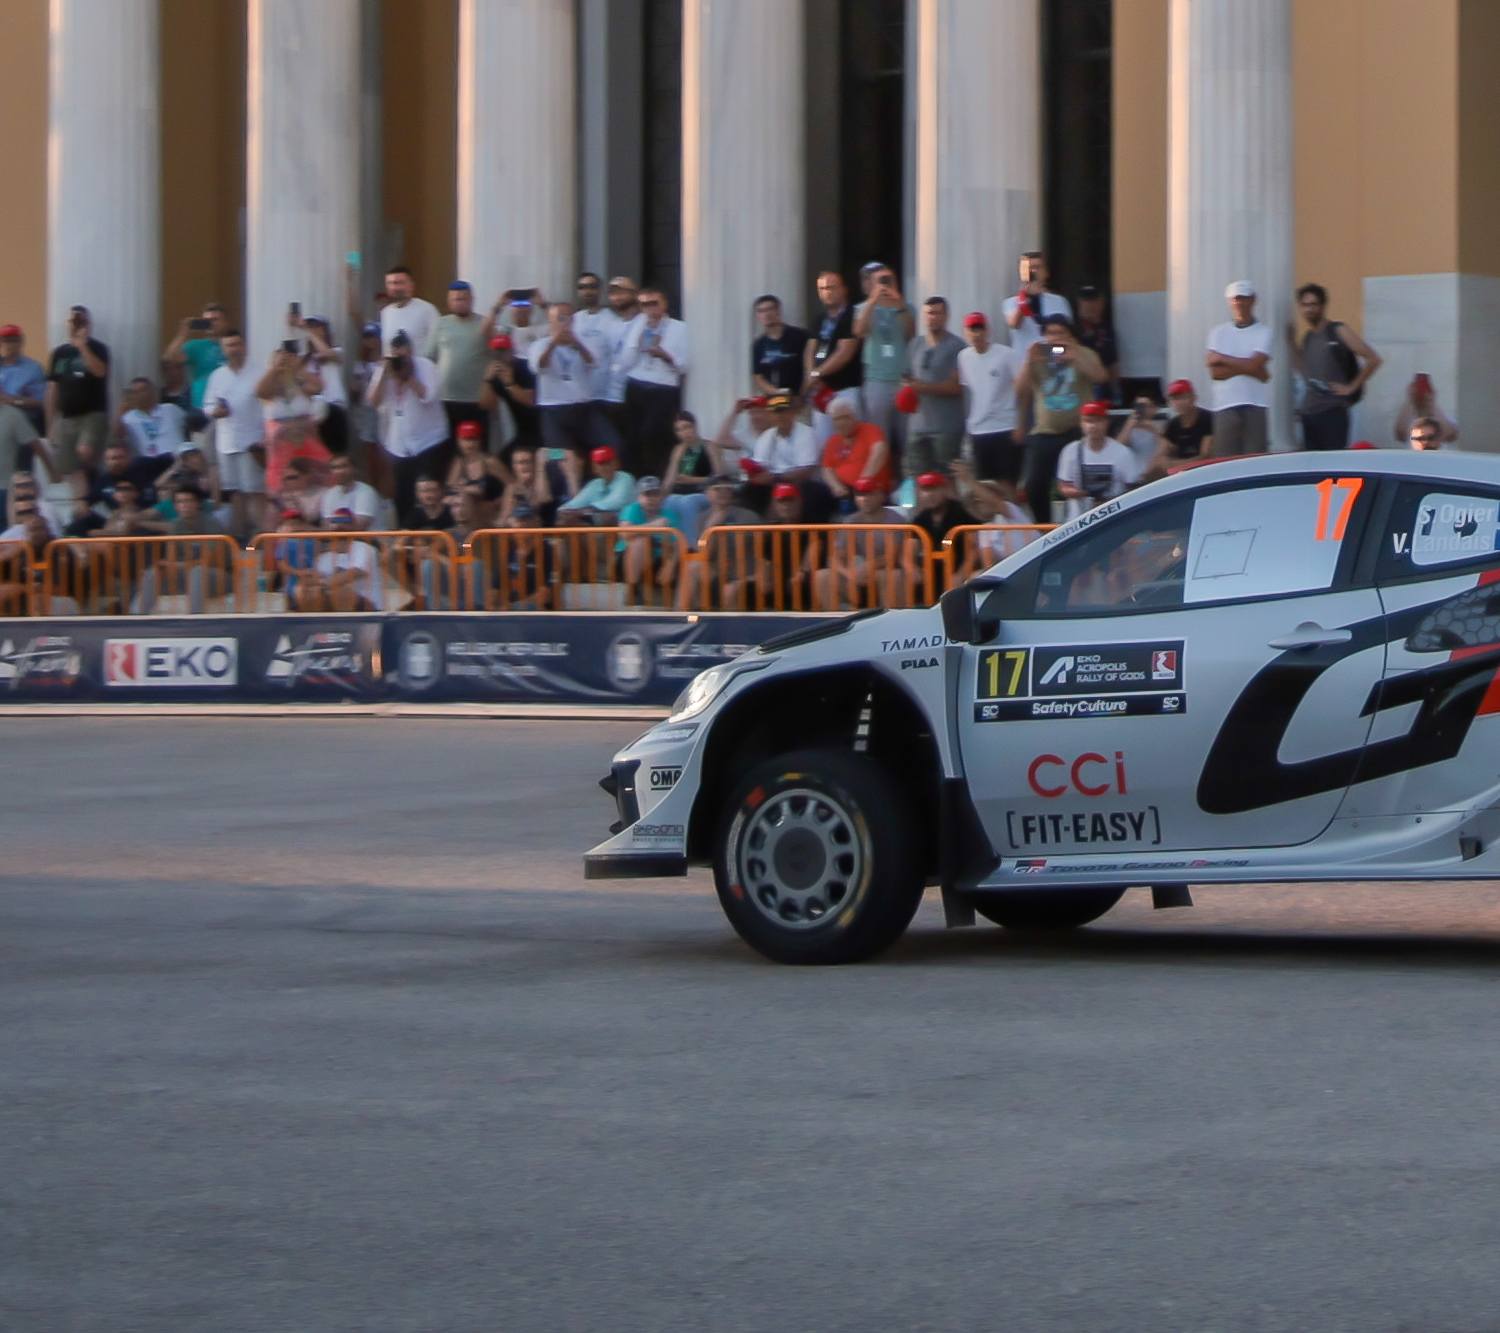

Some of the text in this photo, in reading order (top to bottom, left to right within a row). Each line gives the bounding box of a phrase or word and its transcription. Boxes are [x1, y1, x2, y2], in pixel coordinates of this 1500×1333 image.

[1313, 477, 1365, 541] 17
[146, 645, 232, 678] EKO
[901, 656, 940, 670] PIAA
[985, 650, 1027, 697] 17
[1076, 662, 1128, 673] ACROPOLIS
